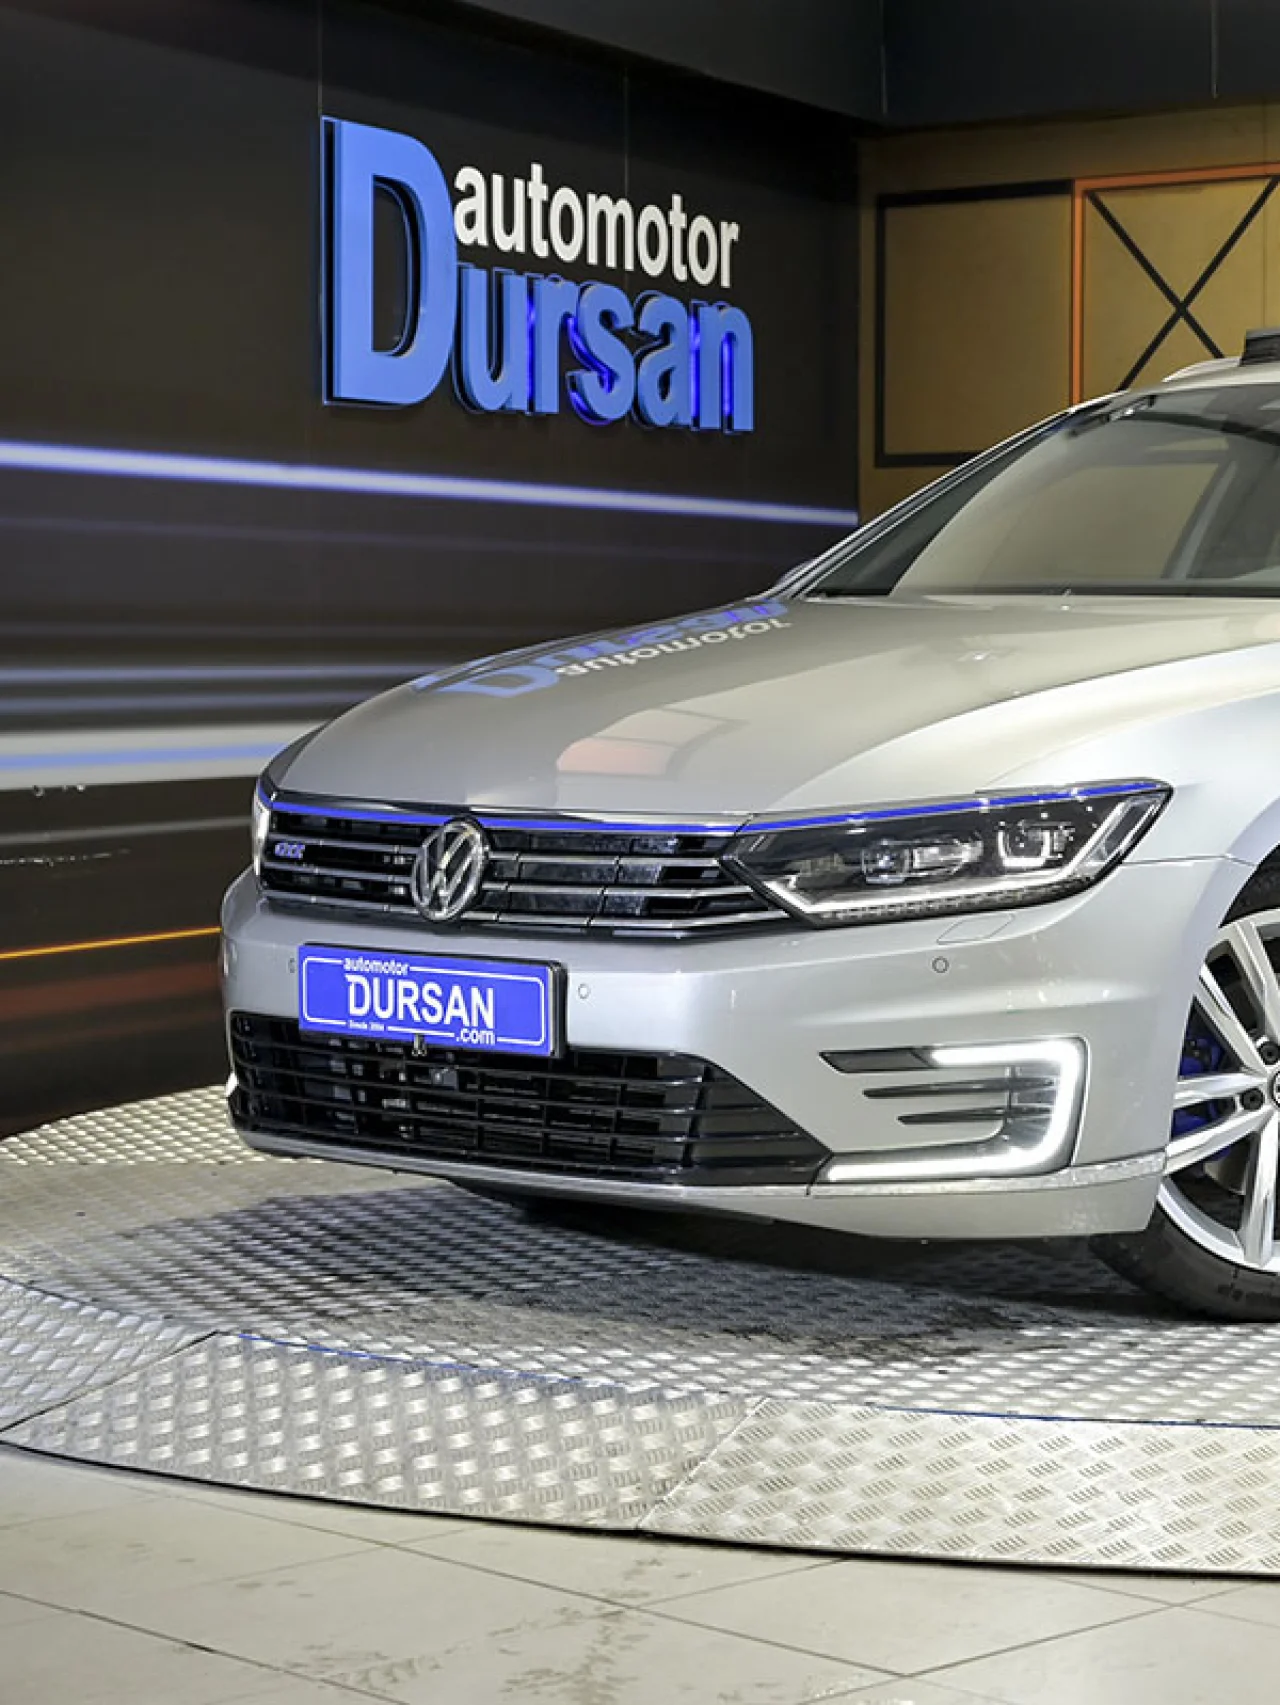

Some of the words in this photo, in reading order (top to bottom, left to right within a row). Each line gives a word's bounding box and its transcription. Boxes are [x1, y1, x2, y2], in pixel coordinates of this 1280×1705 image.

[453, 163, 739, 288] automotor
[321, 115, 754, 434] Dursan
[343, 957, 409, 975] automotor
[345, 974, 494, 1028] DURSAN
[456, 1029, 496, 1045] .com
